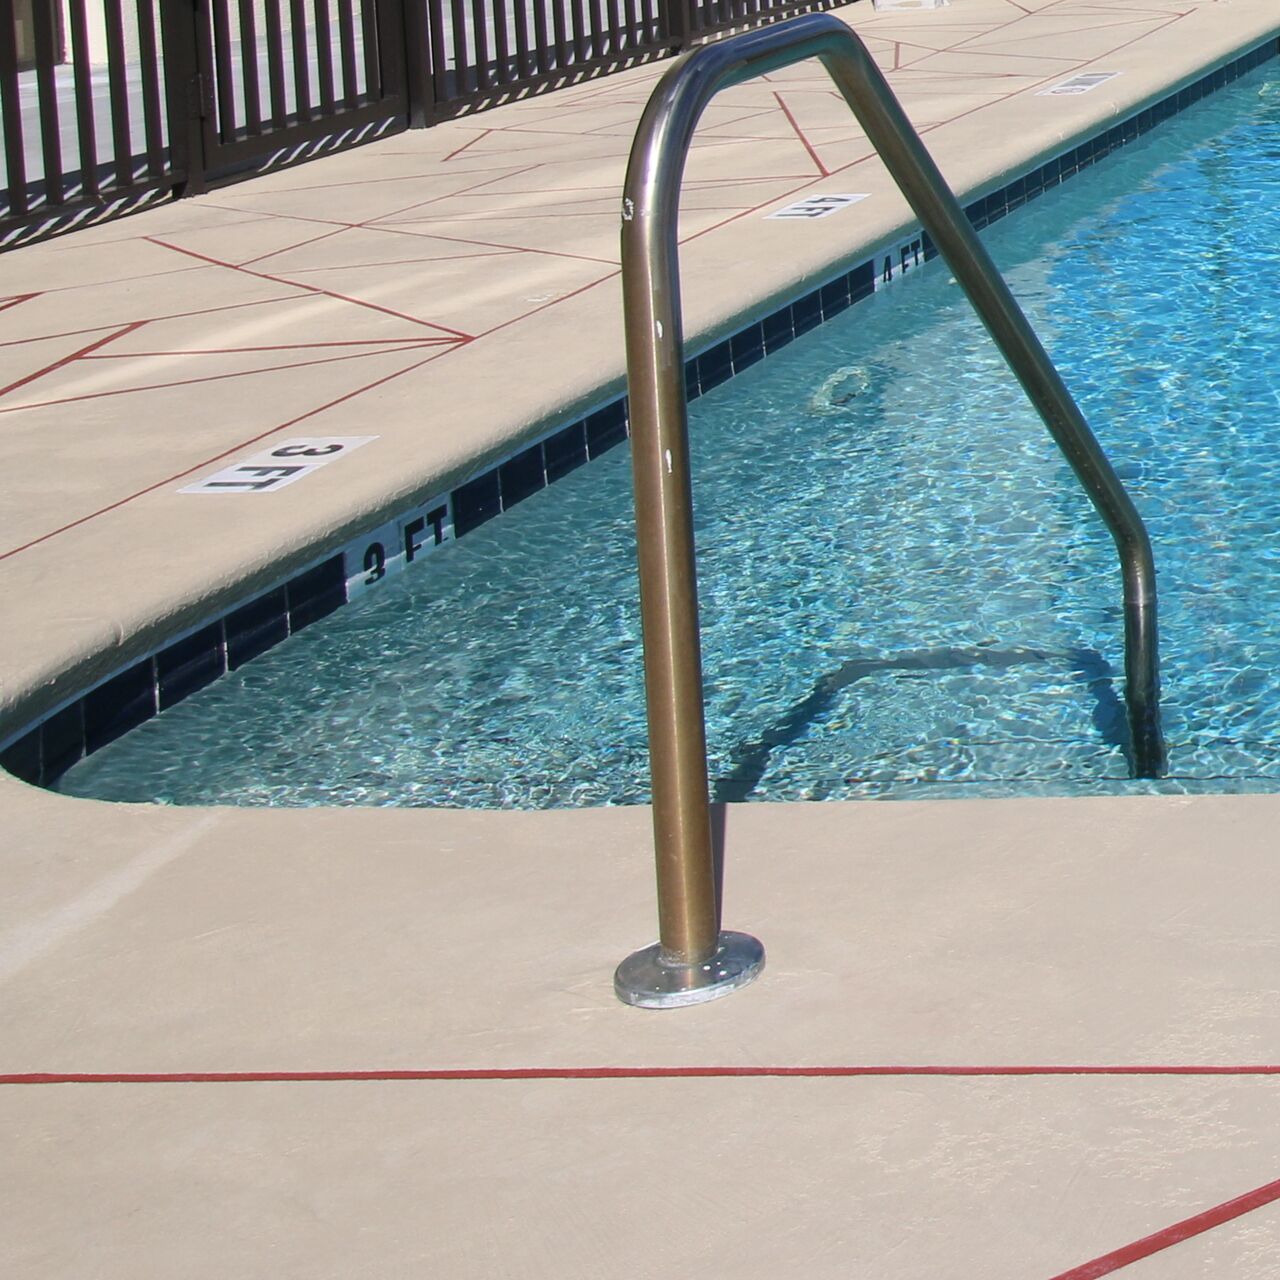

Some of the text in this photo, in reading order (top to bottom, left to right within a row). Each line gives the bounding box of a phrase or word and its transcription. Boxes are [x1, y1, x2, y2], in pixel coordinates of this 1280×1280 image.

[775, 206, 836, 217] FT
[203, 444, 344, 490] 3 FT
